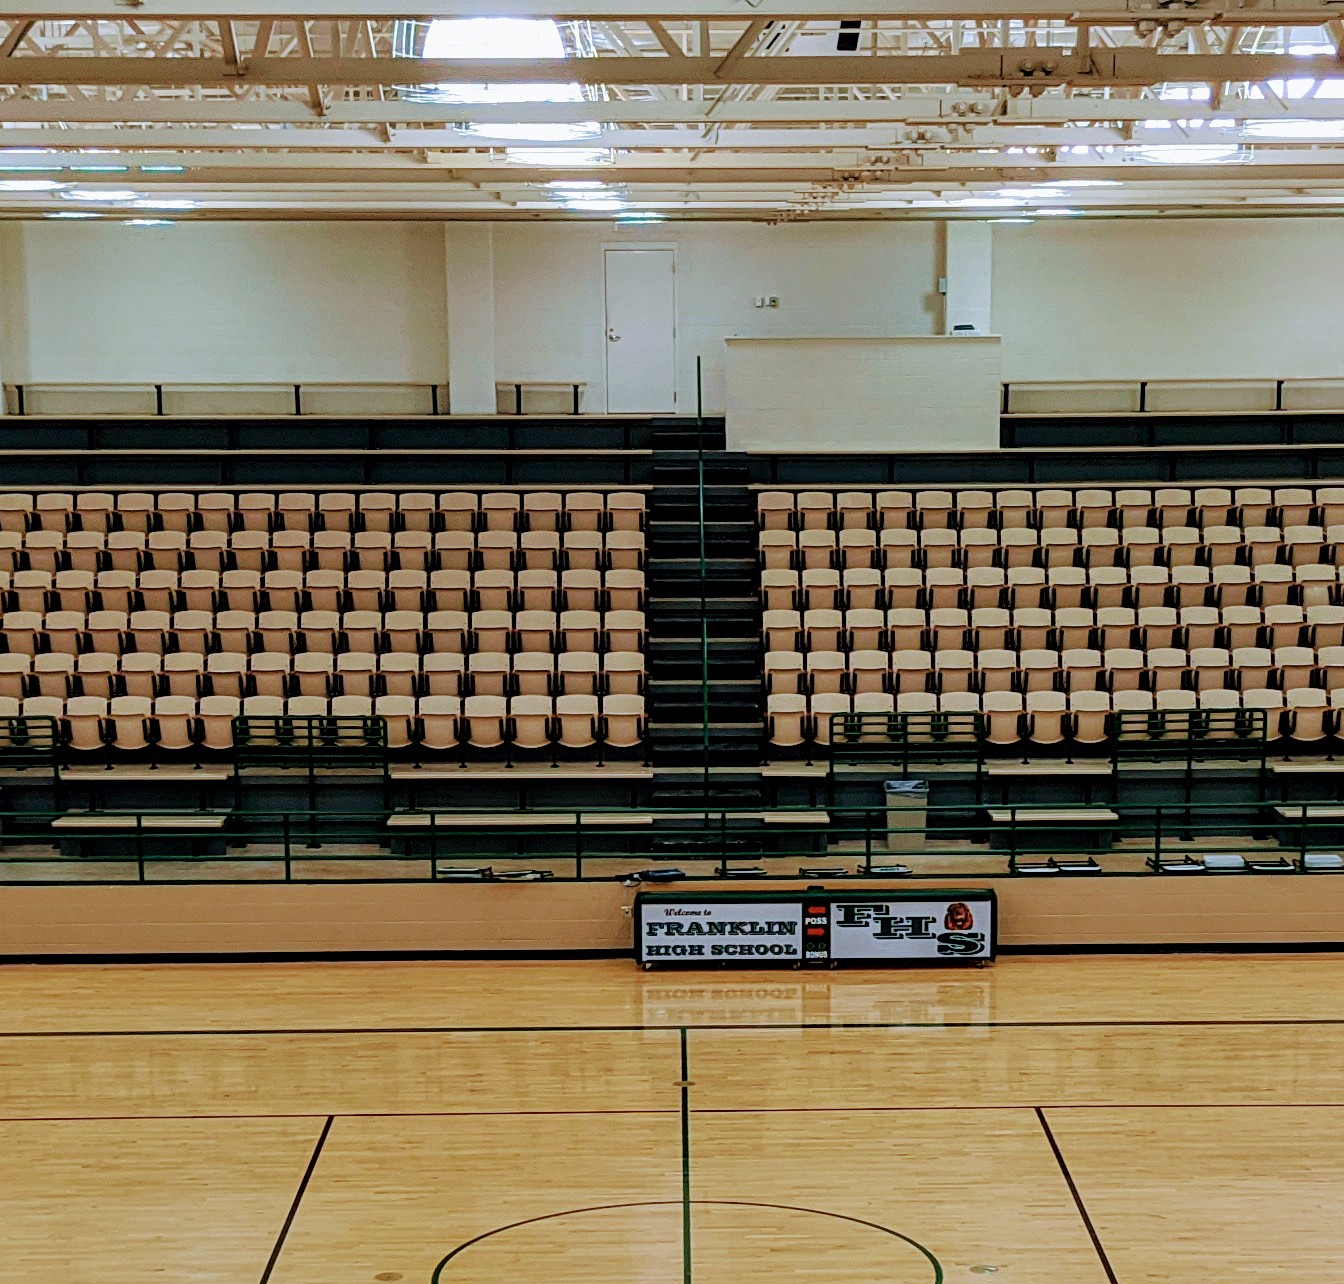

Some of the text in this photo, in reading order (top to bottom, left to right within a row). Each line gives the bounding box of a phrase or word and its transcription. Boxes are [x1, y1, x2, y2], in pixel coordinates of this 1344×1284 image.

[664, 908, 712, 917] Welcome to
[805, 917, 828, 925] POSS
[646, 921, 798, 937] FRANKLIN
[646, 944, 798, 957] HIGH SCHOOL
